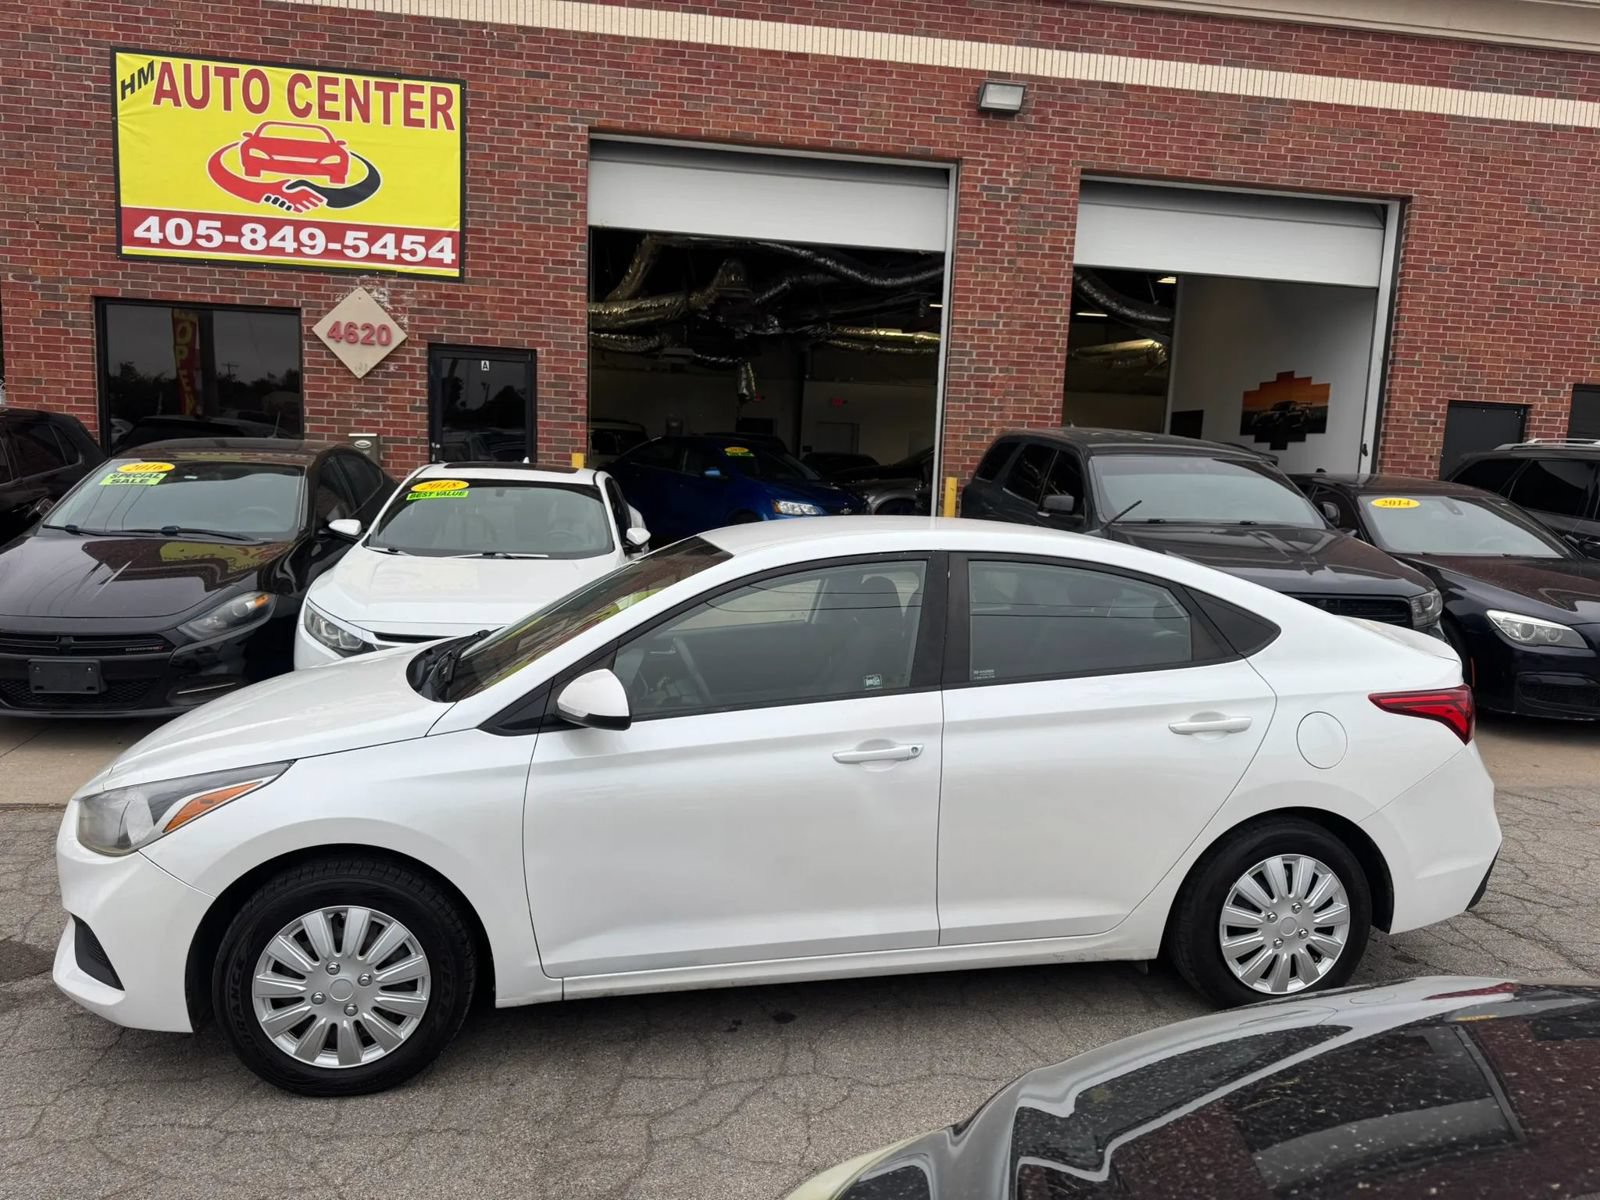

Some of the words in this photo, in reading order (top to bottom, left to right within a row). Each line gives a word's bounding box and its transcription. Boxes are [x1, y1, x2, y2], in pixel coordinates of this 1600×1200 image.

[120, 60, 155, 101] HM
[152, 61, 271, 115] AUTO
[286, 73, 456, 131] CENTER
[133, 215, 456, 264] 405-849-5454
[326, 320, 393, 347] 4620
[409, 491, 433, 499] BEST
